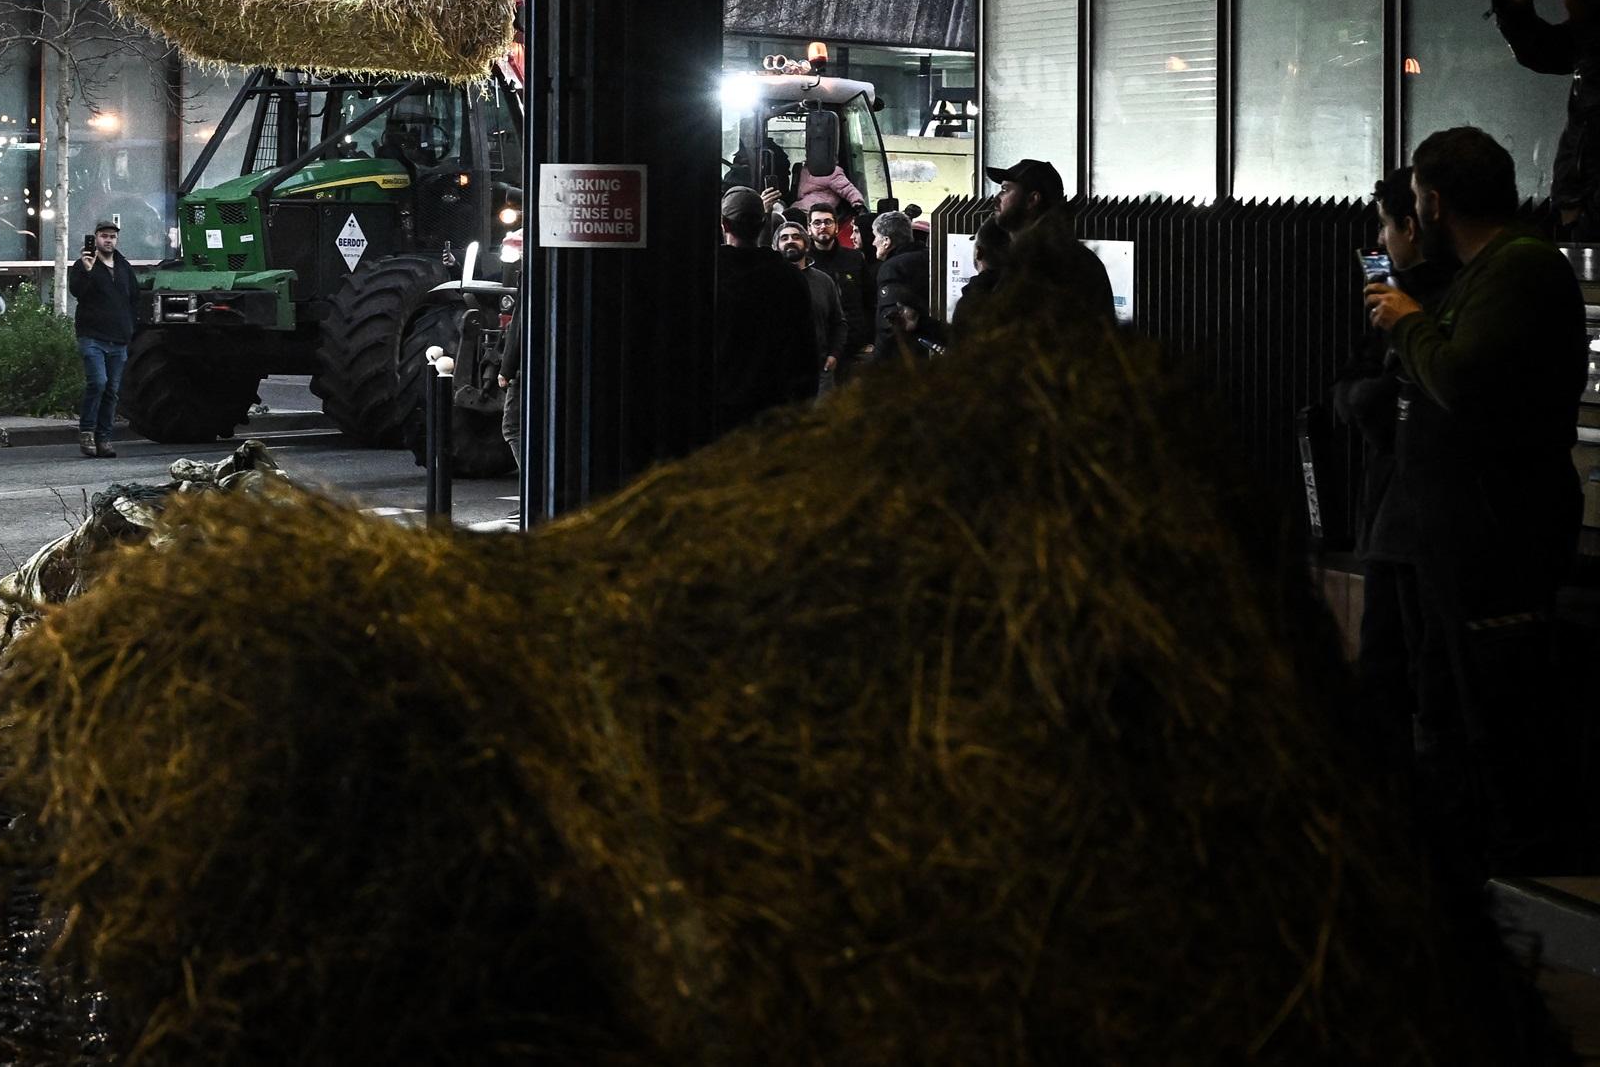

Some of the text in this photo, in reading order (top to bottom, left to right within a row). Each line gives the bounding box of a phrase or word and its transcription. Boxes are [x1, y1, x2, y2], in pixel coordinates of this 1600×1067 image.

[559, 178, 621, 191] PARKING
[568, 190, 611, 205] PRIVÉ
[561, 207, 634, 221] FENSE DE
[563, 221, 635, 235] TIONNER
[338, 237, 366, 248] BERDOT
